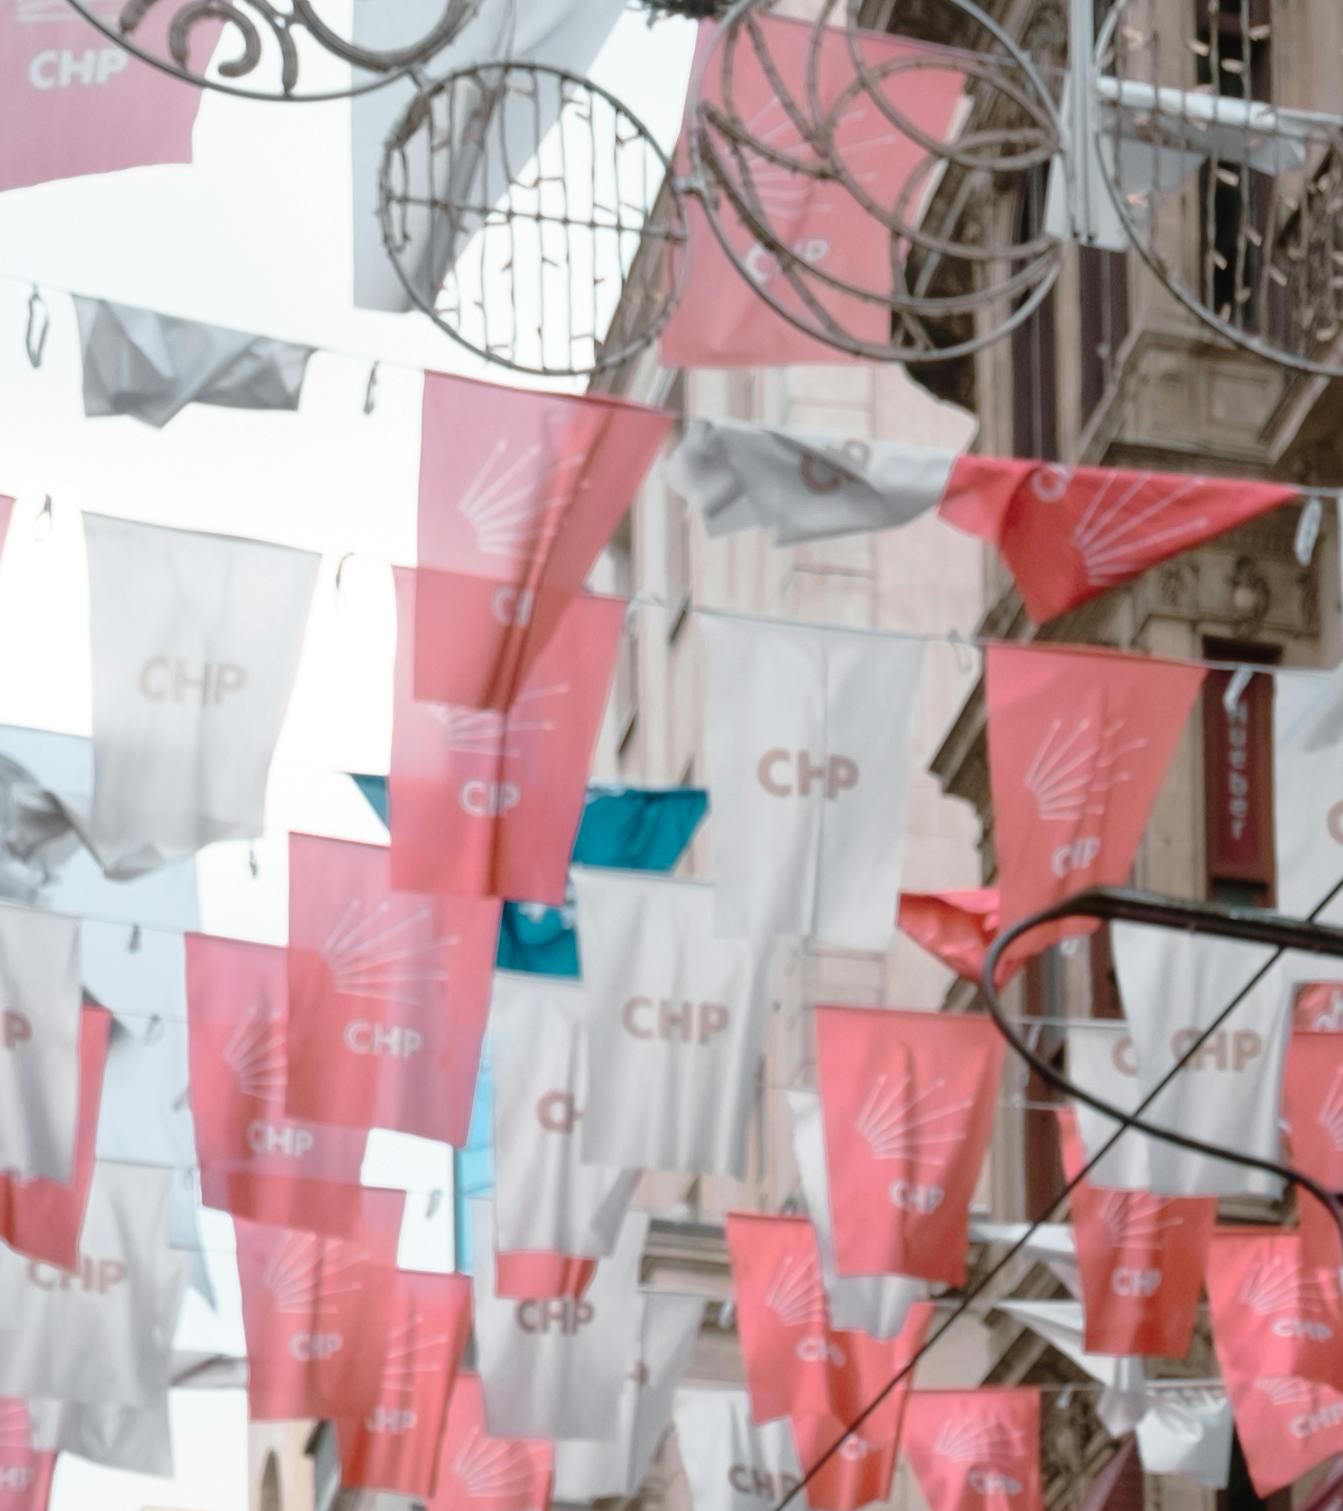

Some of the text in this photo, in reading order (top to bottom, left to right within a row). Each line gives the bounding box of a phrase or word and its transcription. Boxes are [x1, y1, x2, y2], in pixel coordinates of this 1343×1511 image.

[28, 48, 129, 92] CHP
[745, 237, 830, 283] CP
[139, 655, 248, 706] CHP
[757, 748, 861, 801] CHP
[344, 1018, 424, 1060] CHP
[622, 996, 729, 1046] CHP
[1170, 1027, 1264, 1074] CHP
[249, 1121, 314, 1158] CHP
